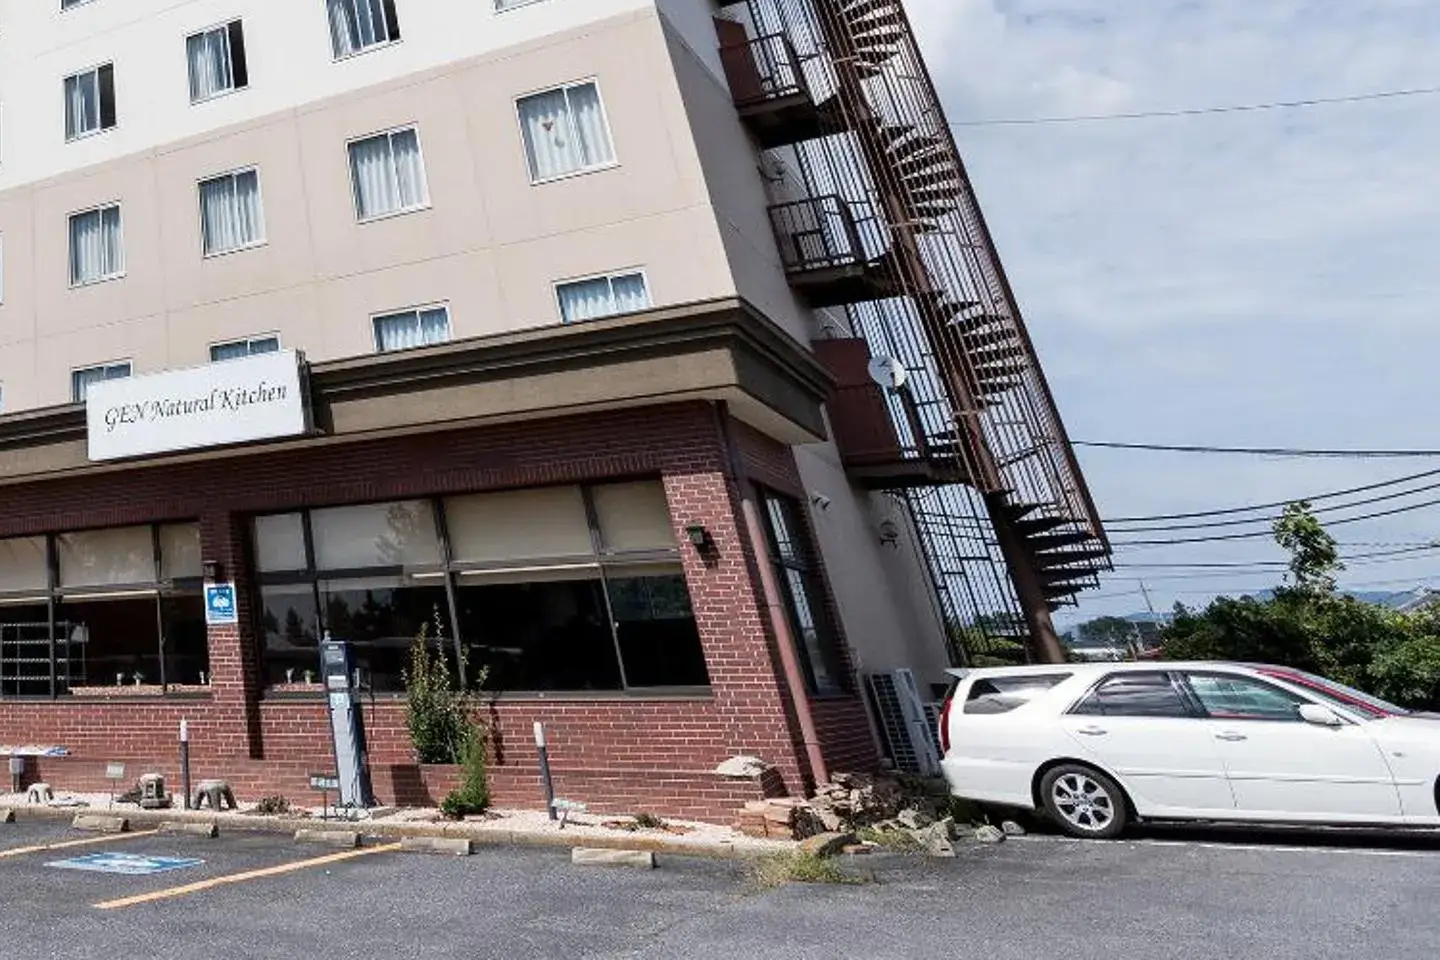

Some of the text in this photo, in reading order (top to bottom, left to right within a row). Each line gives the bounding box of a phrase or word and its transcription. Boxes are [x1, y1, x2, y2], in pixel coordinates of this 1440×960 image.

[105, 381, 287, 432] GEN Natural Kitchen
